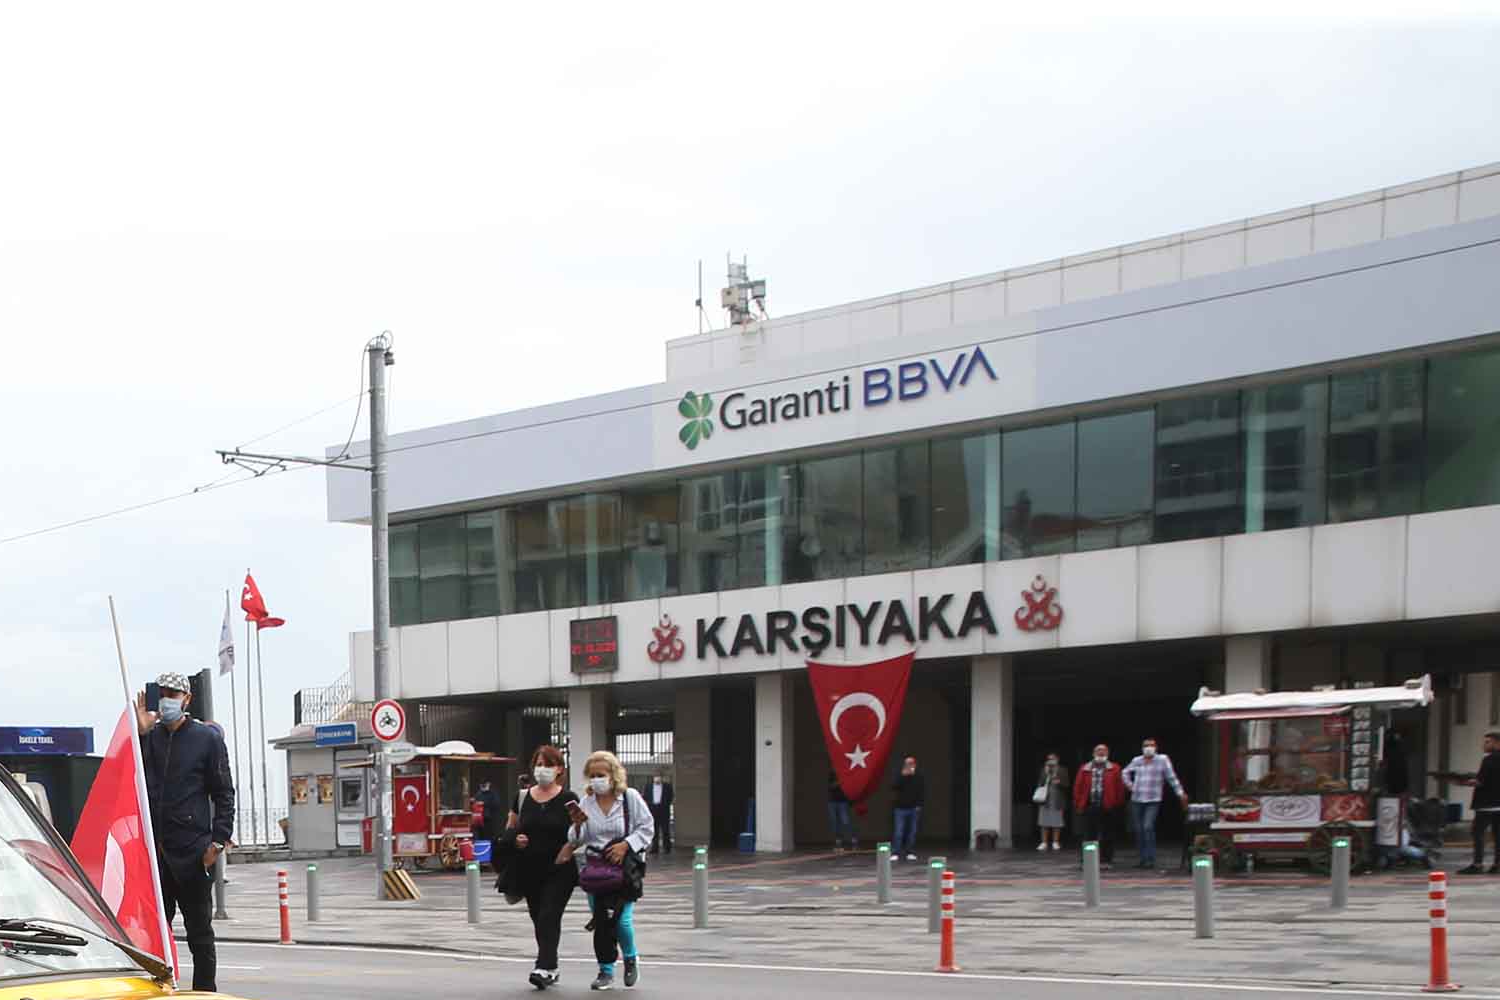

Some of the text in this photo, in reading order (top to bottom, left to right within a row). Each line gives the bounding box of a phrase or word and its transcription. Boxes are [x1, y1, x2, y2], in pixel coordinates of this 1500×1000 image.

[719, 345, 999, 430] Garanti BBVA
[696, 591, 999, 659] KARŞIYAKA
